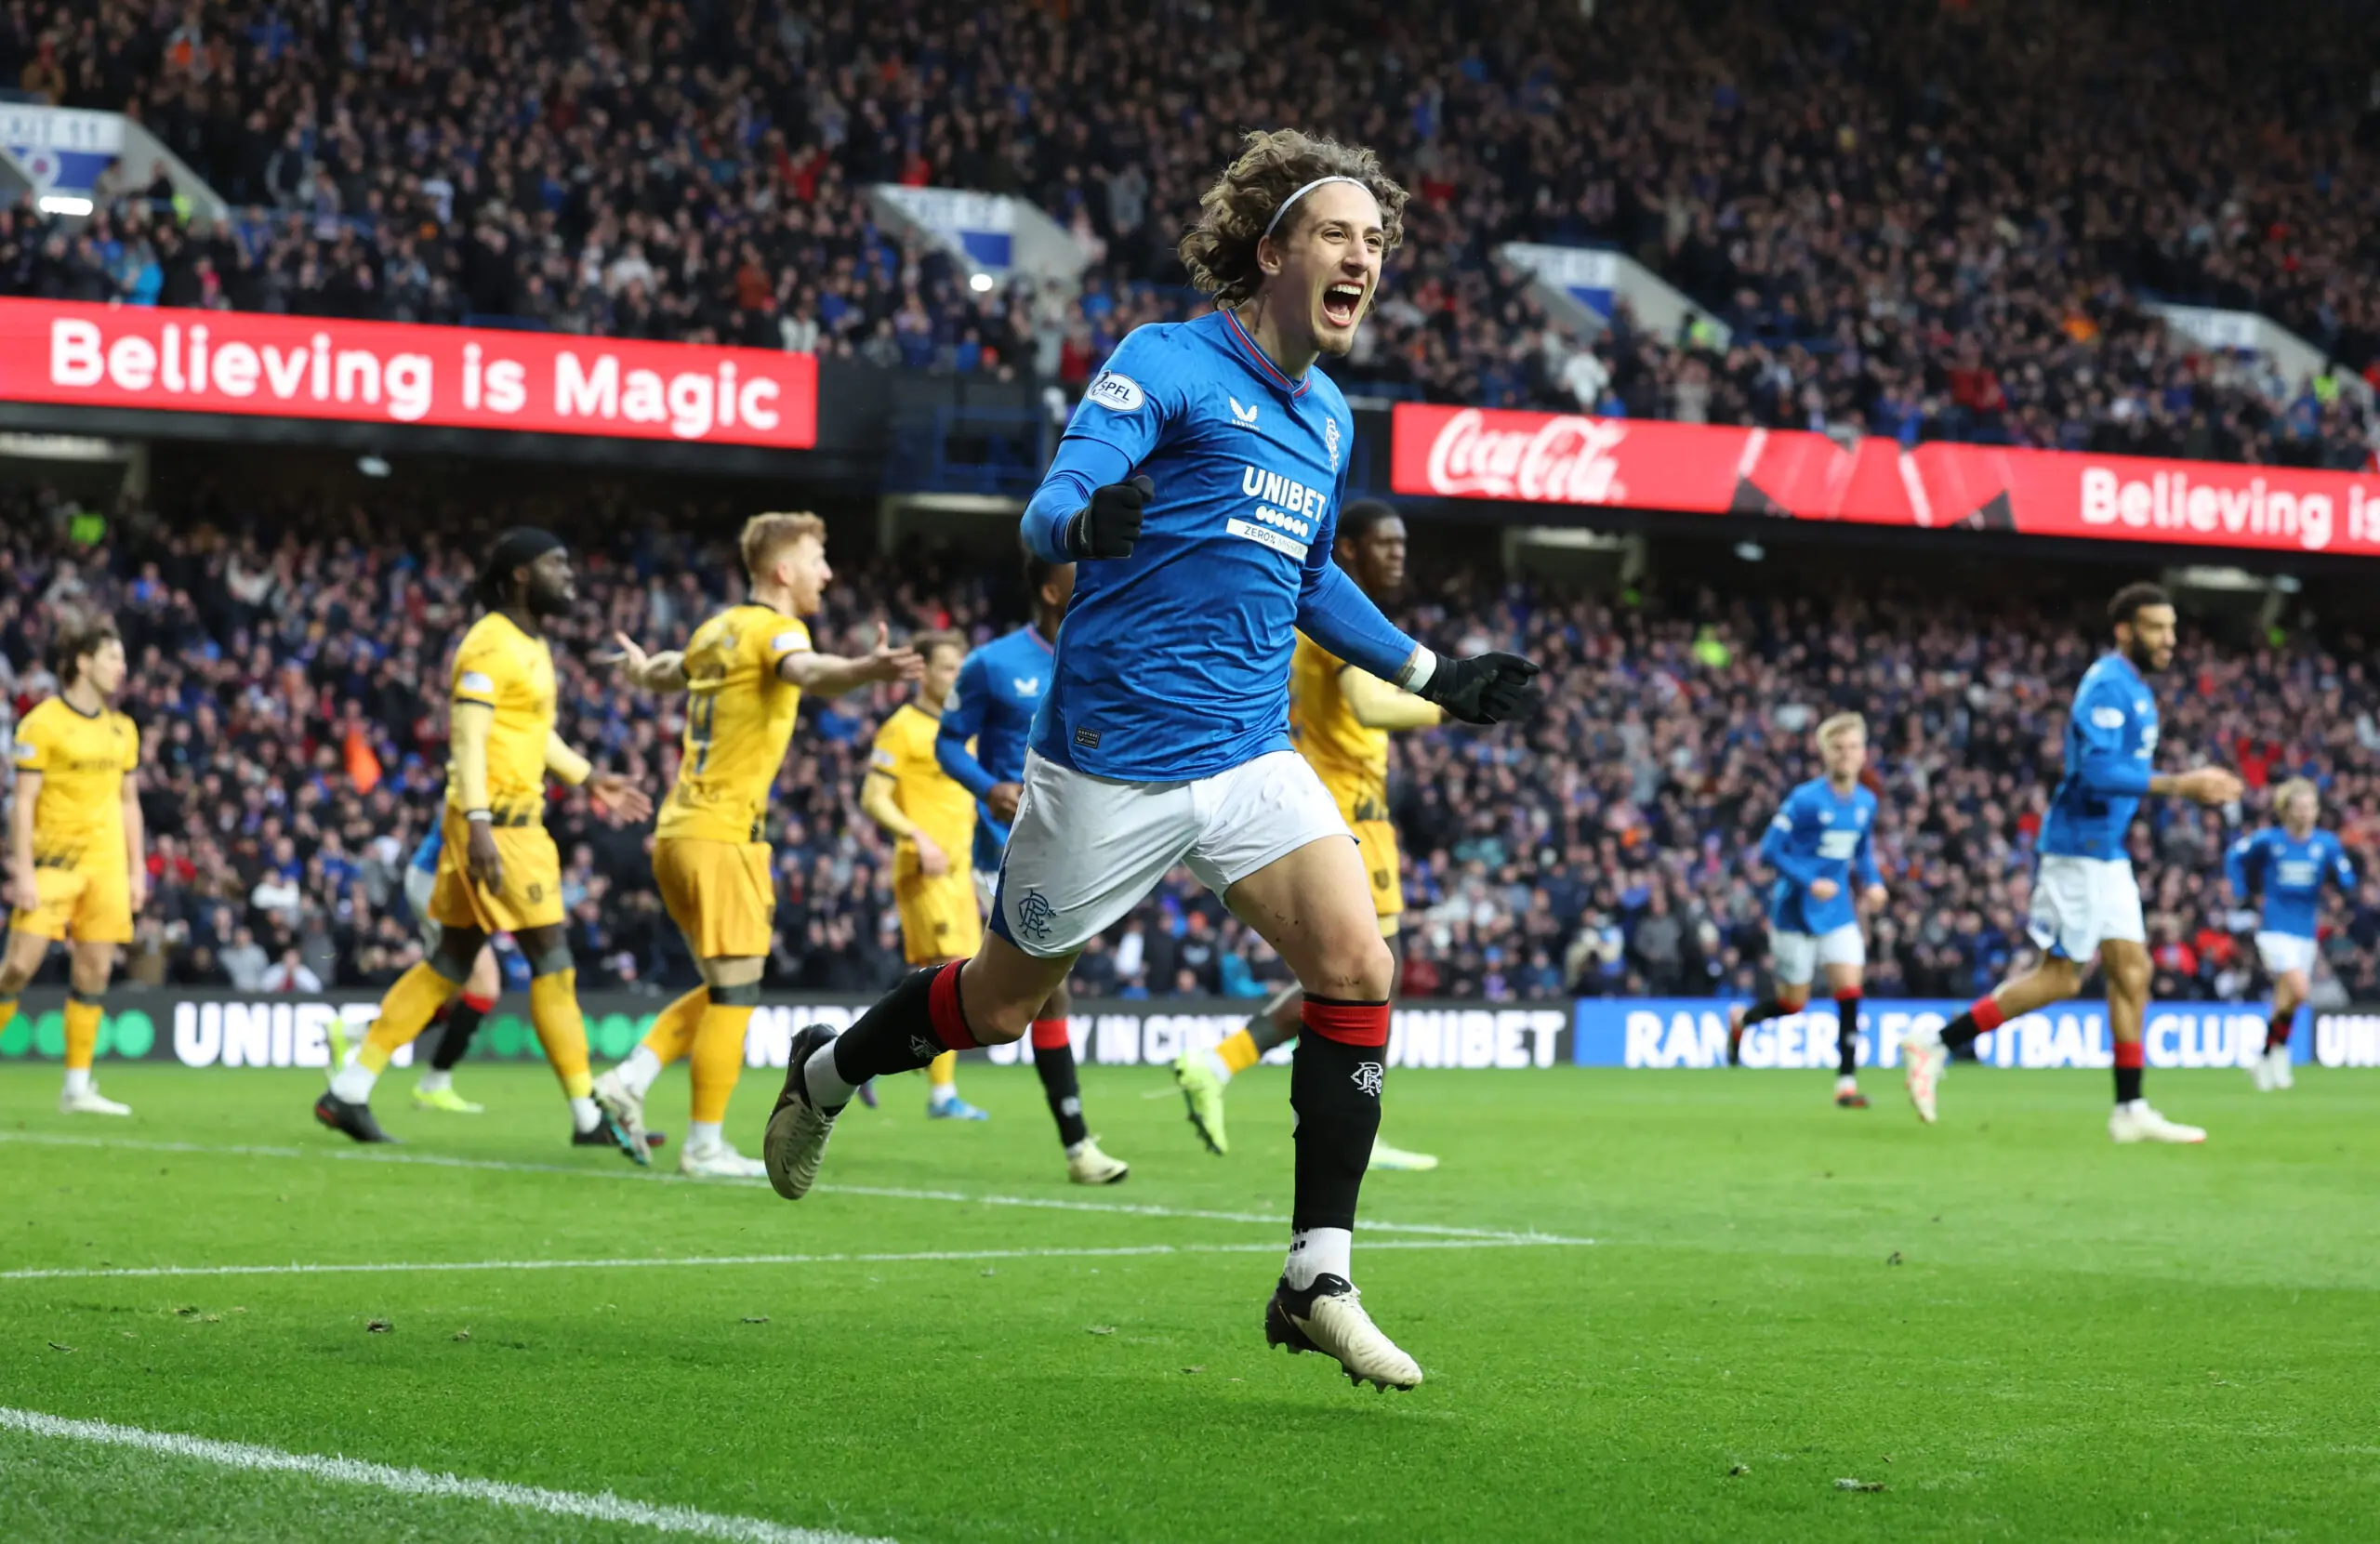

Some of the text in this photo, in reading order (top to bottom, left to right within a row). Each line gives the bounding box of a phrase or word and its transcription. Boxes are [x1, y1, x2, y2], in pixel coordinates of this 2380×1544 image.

[50, 319, 781, 439] Believing is Magic
[1098, 381, 1130, 402] SPFL
[1242, 465, 1327, 522] UNIBET
[2080, 467, 2334, 550] Believing
